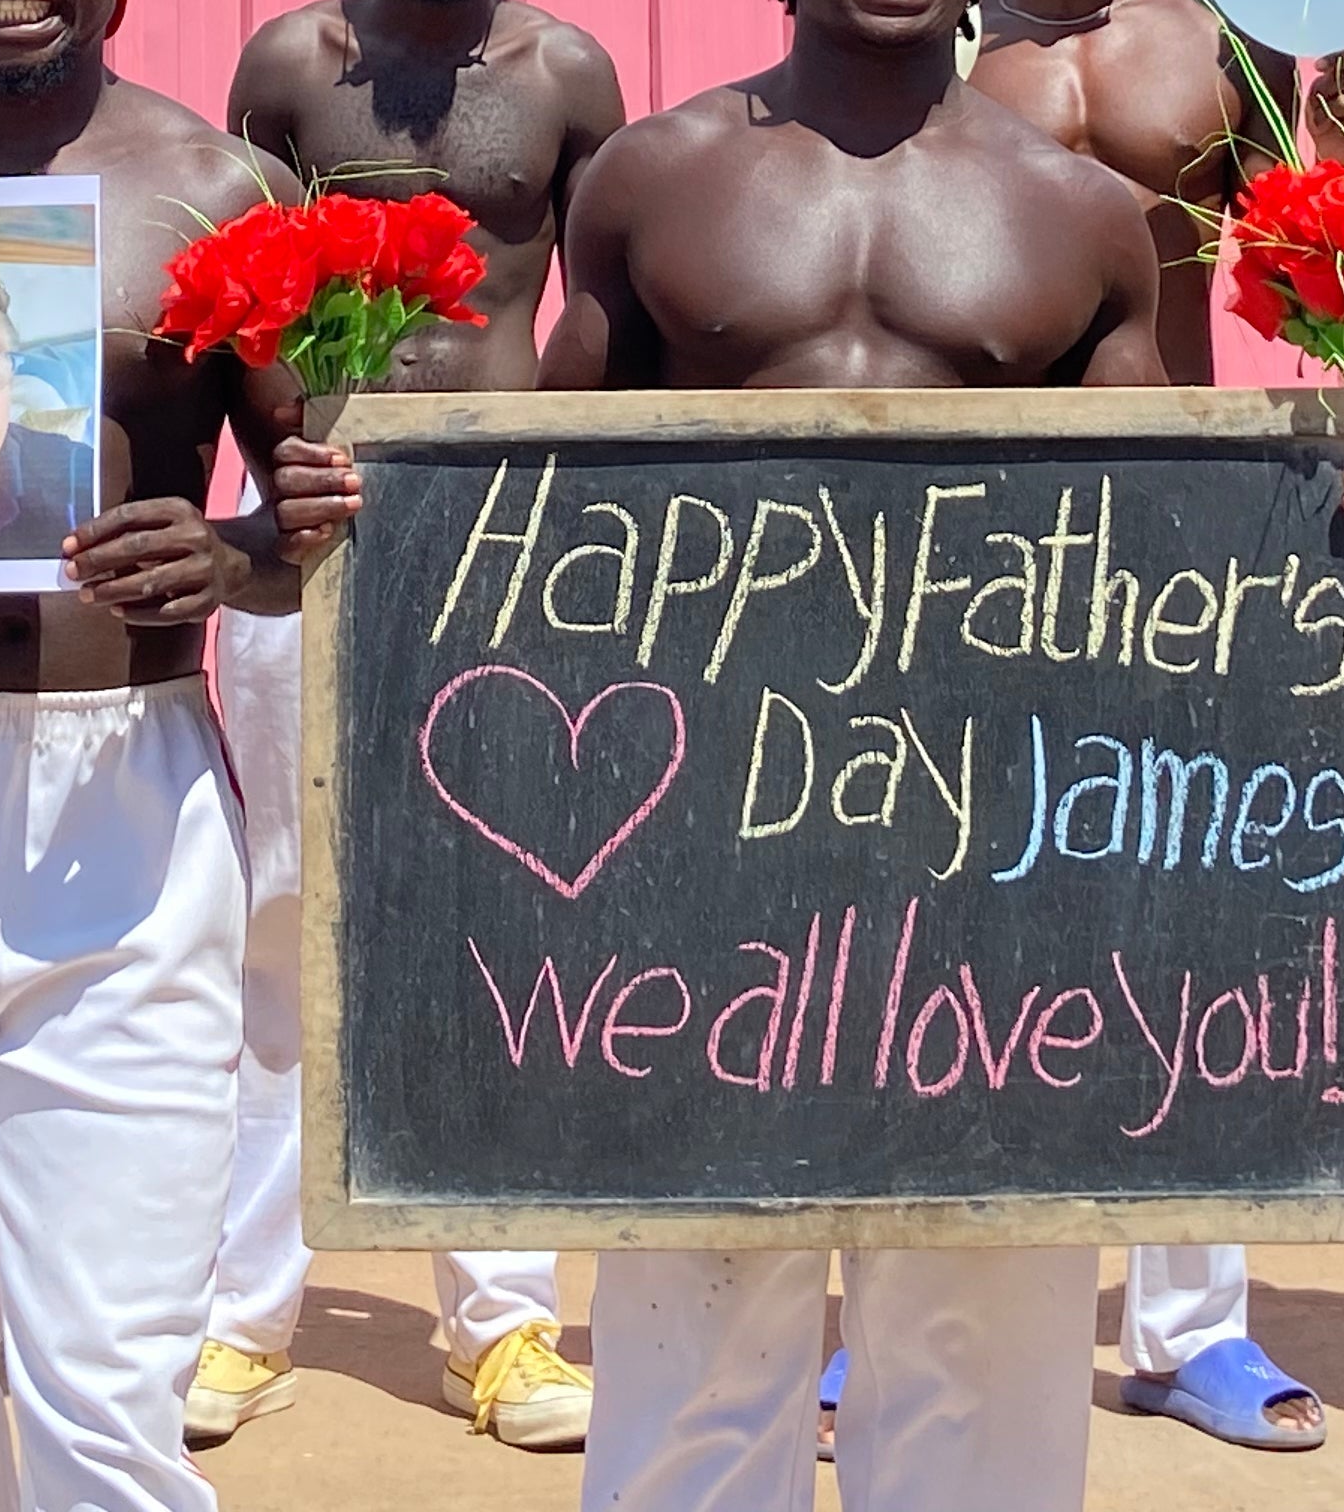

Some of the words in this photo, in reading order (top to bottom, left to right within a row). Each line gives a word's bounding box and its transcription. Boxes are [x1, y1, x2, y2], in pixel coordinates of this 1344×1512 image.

[429, 453, 887, 693] Happy
[740, 687, 976, 880] Day
[707, 905, 858, 1091] all
[875, 897, 1103, 1097] love
